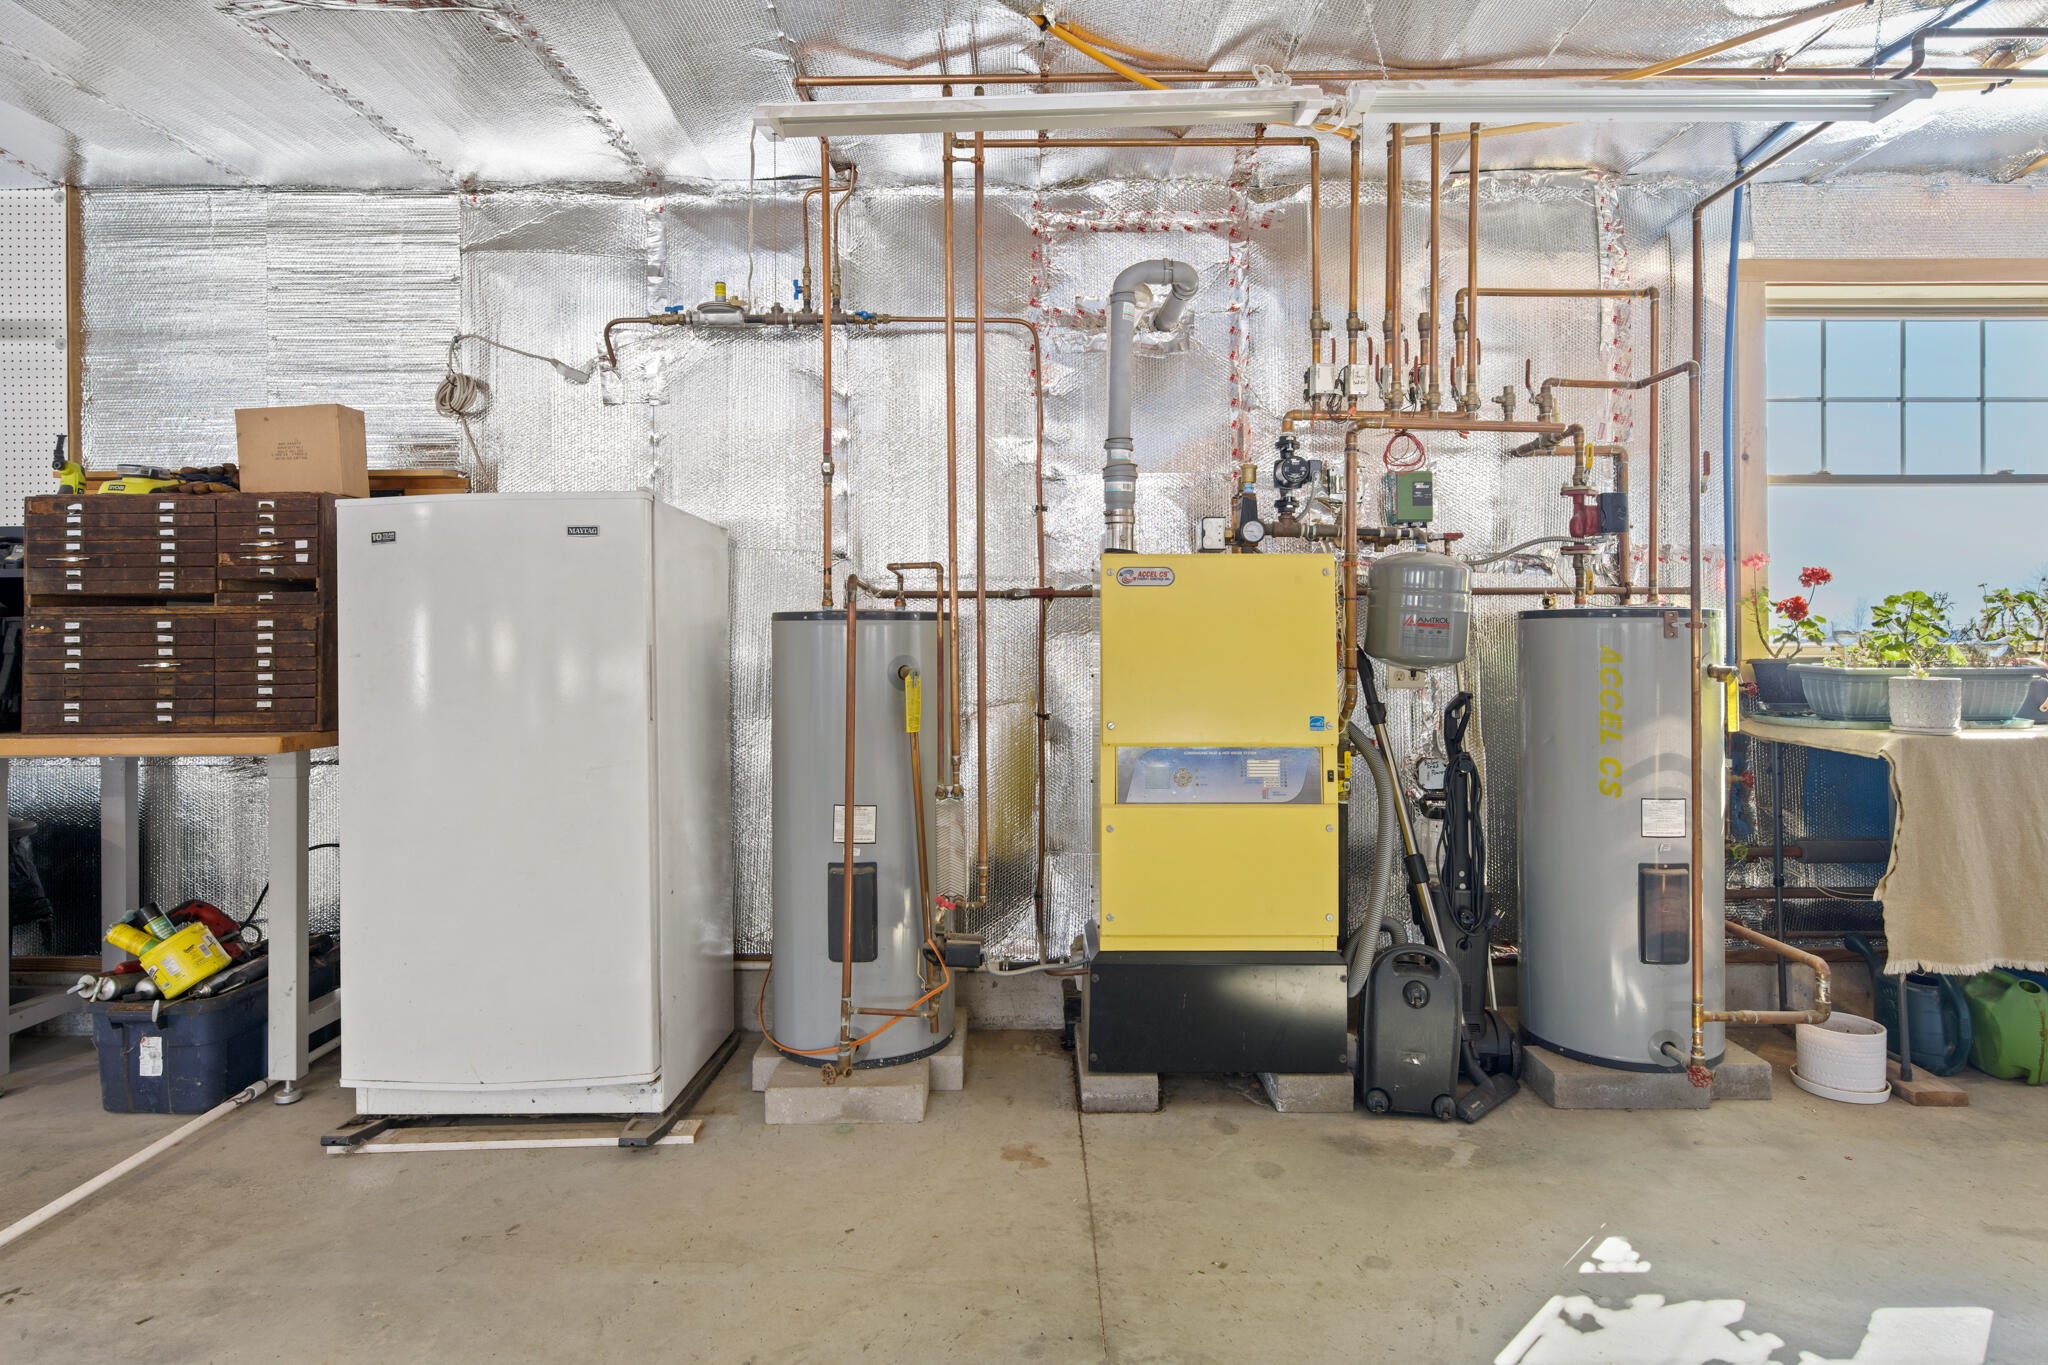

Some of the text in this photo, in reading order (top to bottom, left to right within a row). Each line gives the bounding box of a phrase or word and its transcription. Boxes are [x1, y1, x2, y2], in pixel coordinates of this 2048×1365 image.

[372, 533, 382, 541] 10
[1138, 570, 1158, 578] ACCEL
[1417, 616, 1449, 624] AMTROL
[1599, 644, 1623, 745] ACCEL
[1598, 756, 1623, 798] CS
